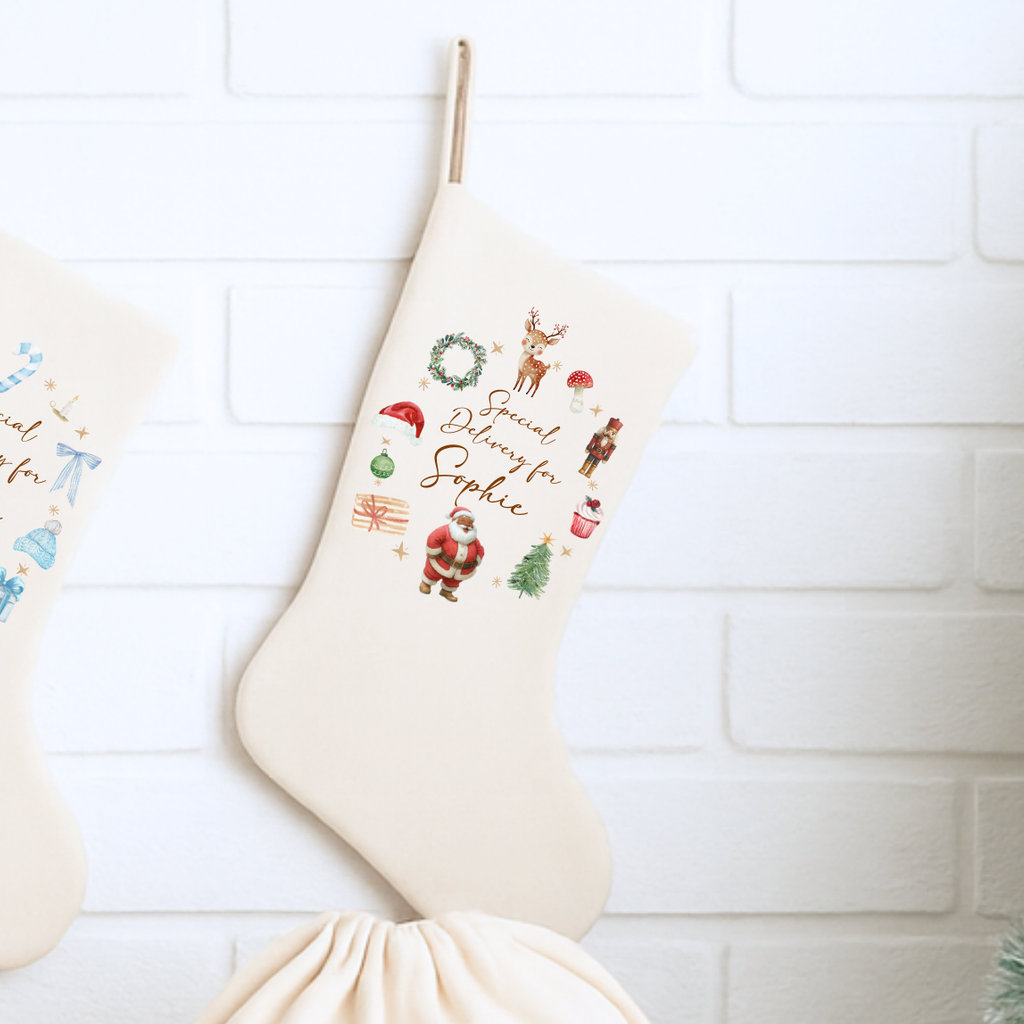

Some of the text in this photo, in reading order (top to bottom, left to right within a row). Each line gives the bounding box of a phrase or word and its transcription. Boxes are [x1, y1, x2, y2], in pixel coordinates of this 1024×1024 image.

[440, 407, 561, 485] Delivery for
[479, 389, 561, 445] Special
[7, 458, 46, 484] for
[420, 444, 528, 516] Sophie
